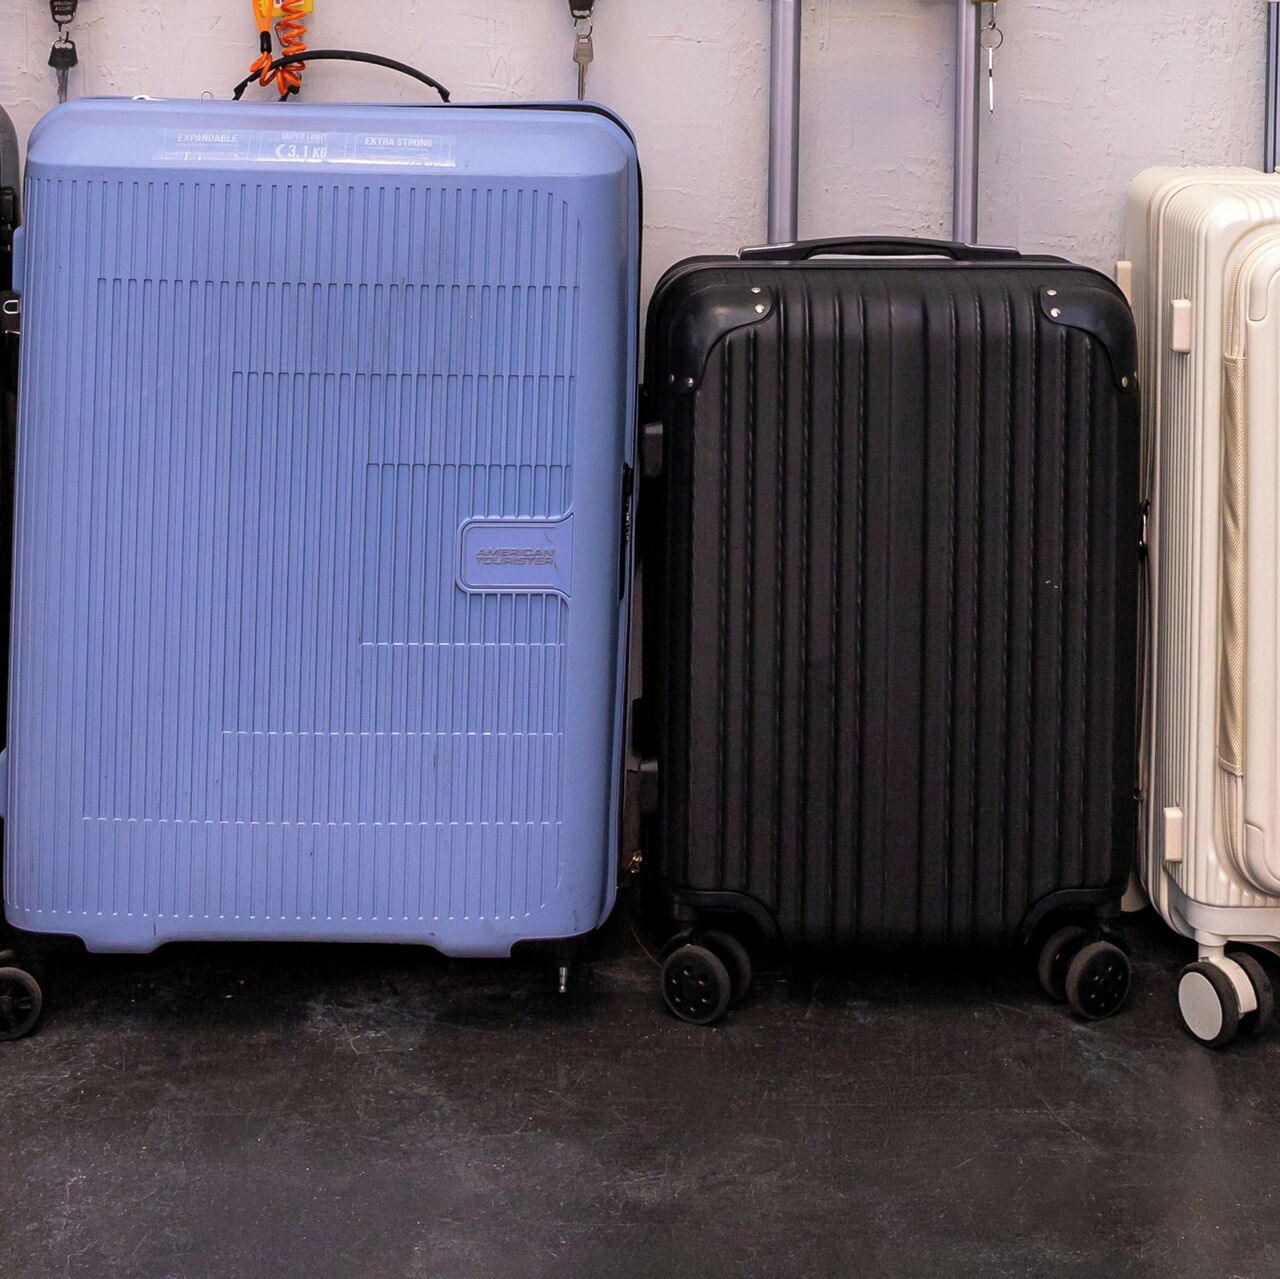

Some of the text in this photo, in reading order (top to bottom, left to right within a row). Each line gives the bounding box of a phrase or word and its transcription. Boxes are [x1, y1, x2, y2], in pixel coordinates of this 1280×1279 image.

[177, 133, 238, 143] EXPANDABLE
[364, 136, 433, 148] EXTRA STRONG
[287, 144, 309, 158] 3.1
[475, 547, 555, 557] AMERICAN
[475, 557, 555, 566] TOURISTER
